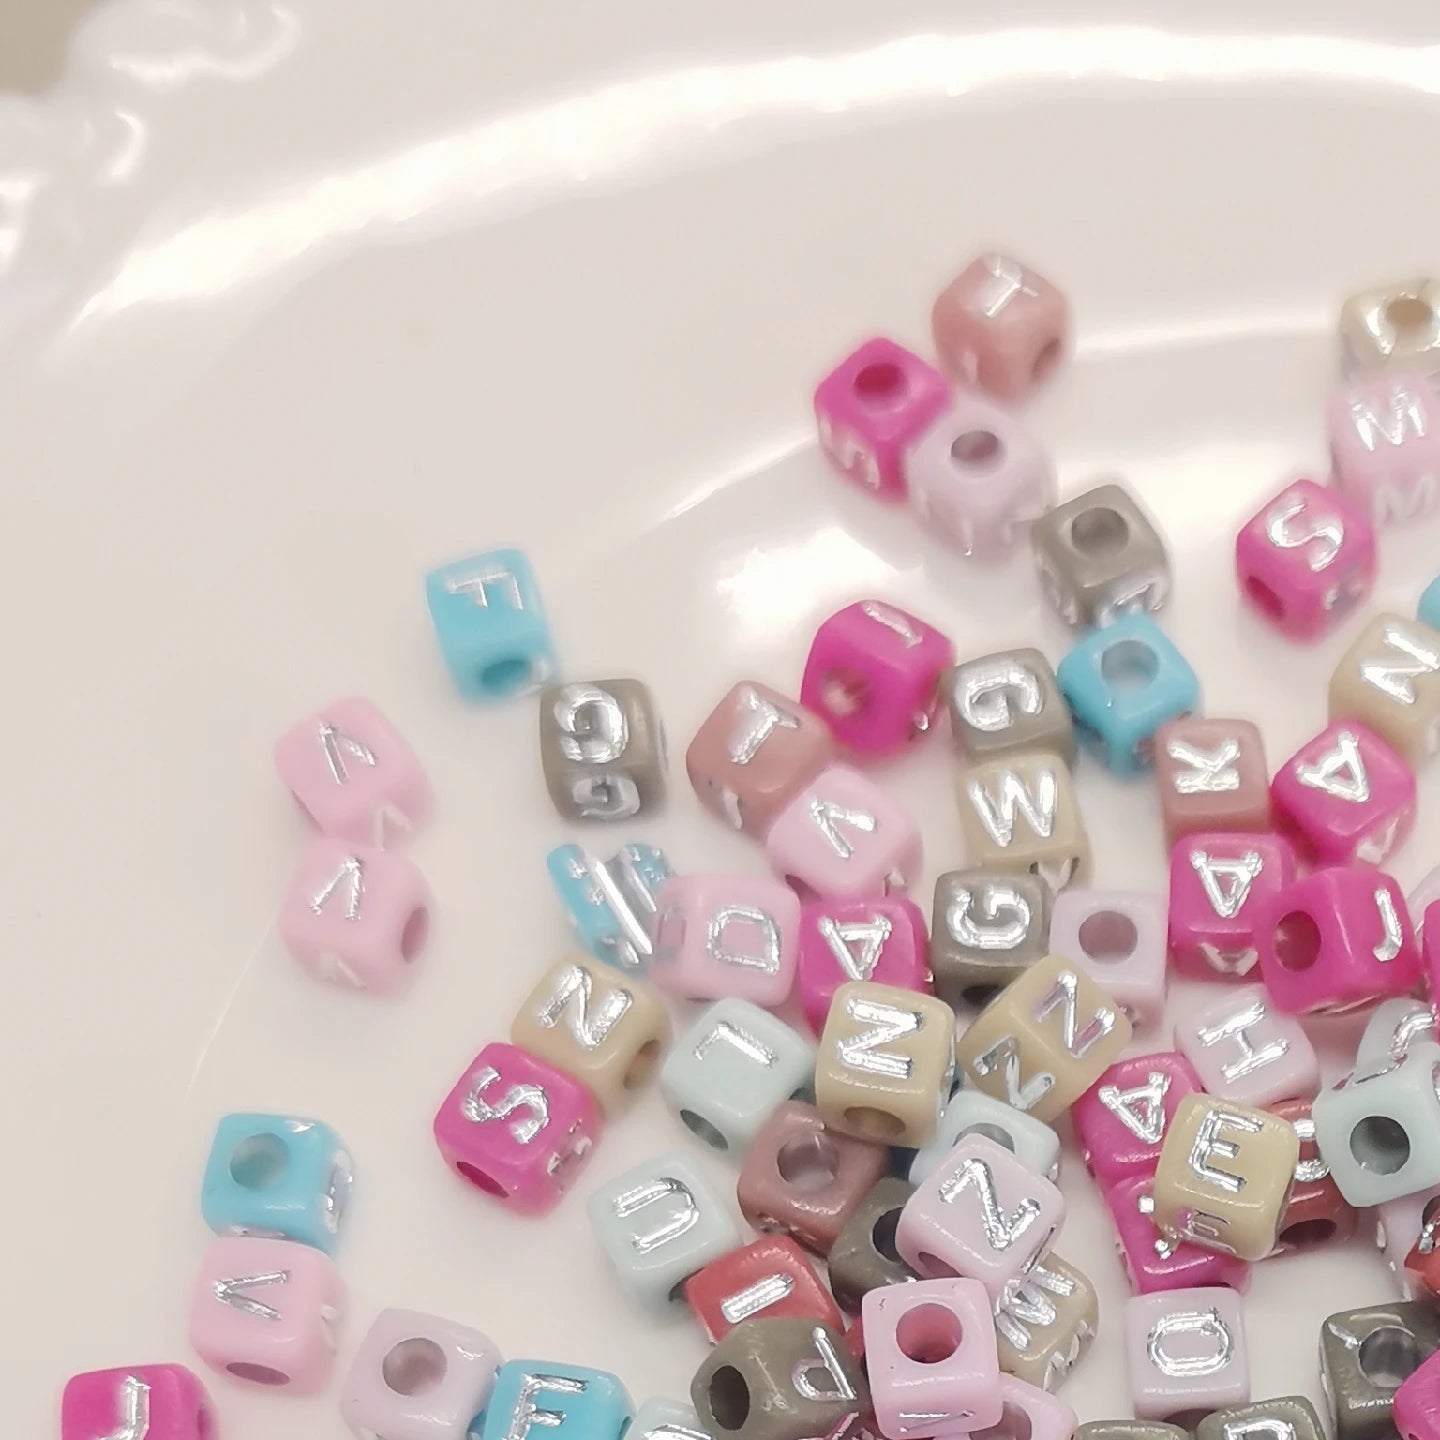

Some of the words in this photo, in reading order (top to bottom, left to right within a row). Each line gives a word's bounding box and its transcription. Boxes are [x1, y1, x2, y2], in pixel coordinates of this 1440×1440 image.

[1352, 387, 1426, 451] M
[1267, 502, 1343, 571] S
[445, 570, 524, 610] F
[553, 684, 629, 763] G
[730, 688, 799, 765] T
[955, 661, 1043, 731] G
[1167, 739, 1240, 794] K
[1296, 731, 1370, 802] A
[810, 800, 877, 858] V
[968, 770, 1057, 847] W
[309, 856, 366, 919] V
[948, 887, 1030, 949] G
[1191, 851, 1264, 918] A
[707, 906, 779, 974] D
[820, 914, 892, 980] A
[1373, 888, 1403, 961] J
[536, 963, 634, 1050] N
[1199, 1003, 1290, 1083] H
[463, 1066, 550, 1144] S
[1099, 1073, 1172, 1144] A
[1188, 1110, 1264, 1193] E
[611, 1175, 700, 1255] U
[212, 1269, 290, 1321] V
[721, 1273, 794, 1325] I
[792, 1325, 858, 1402] P
